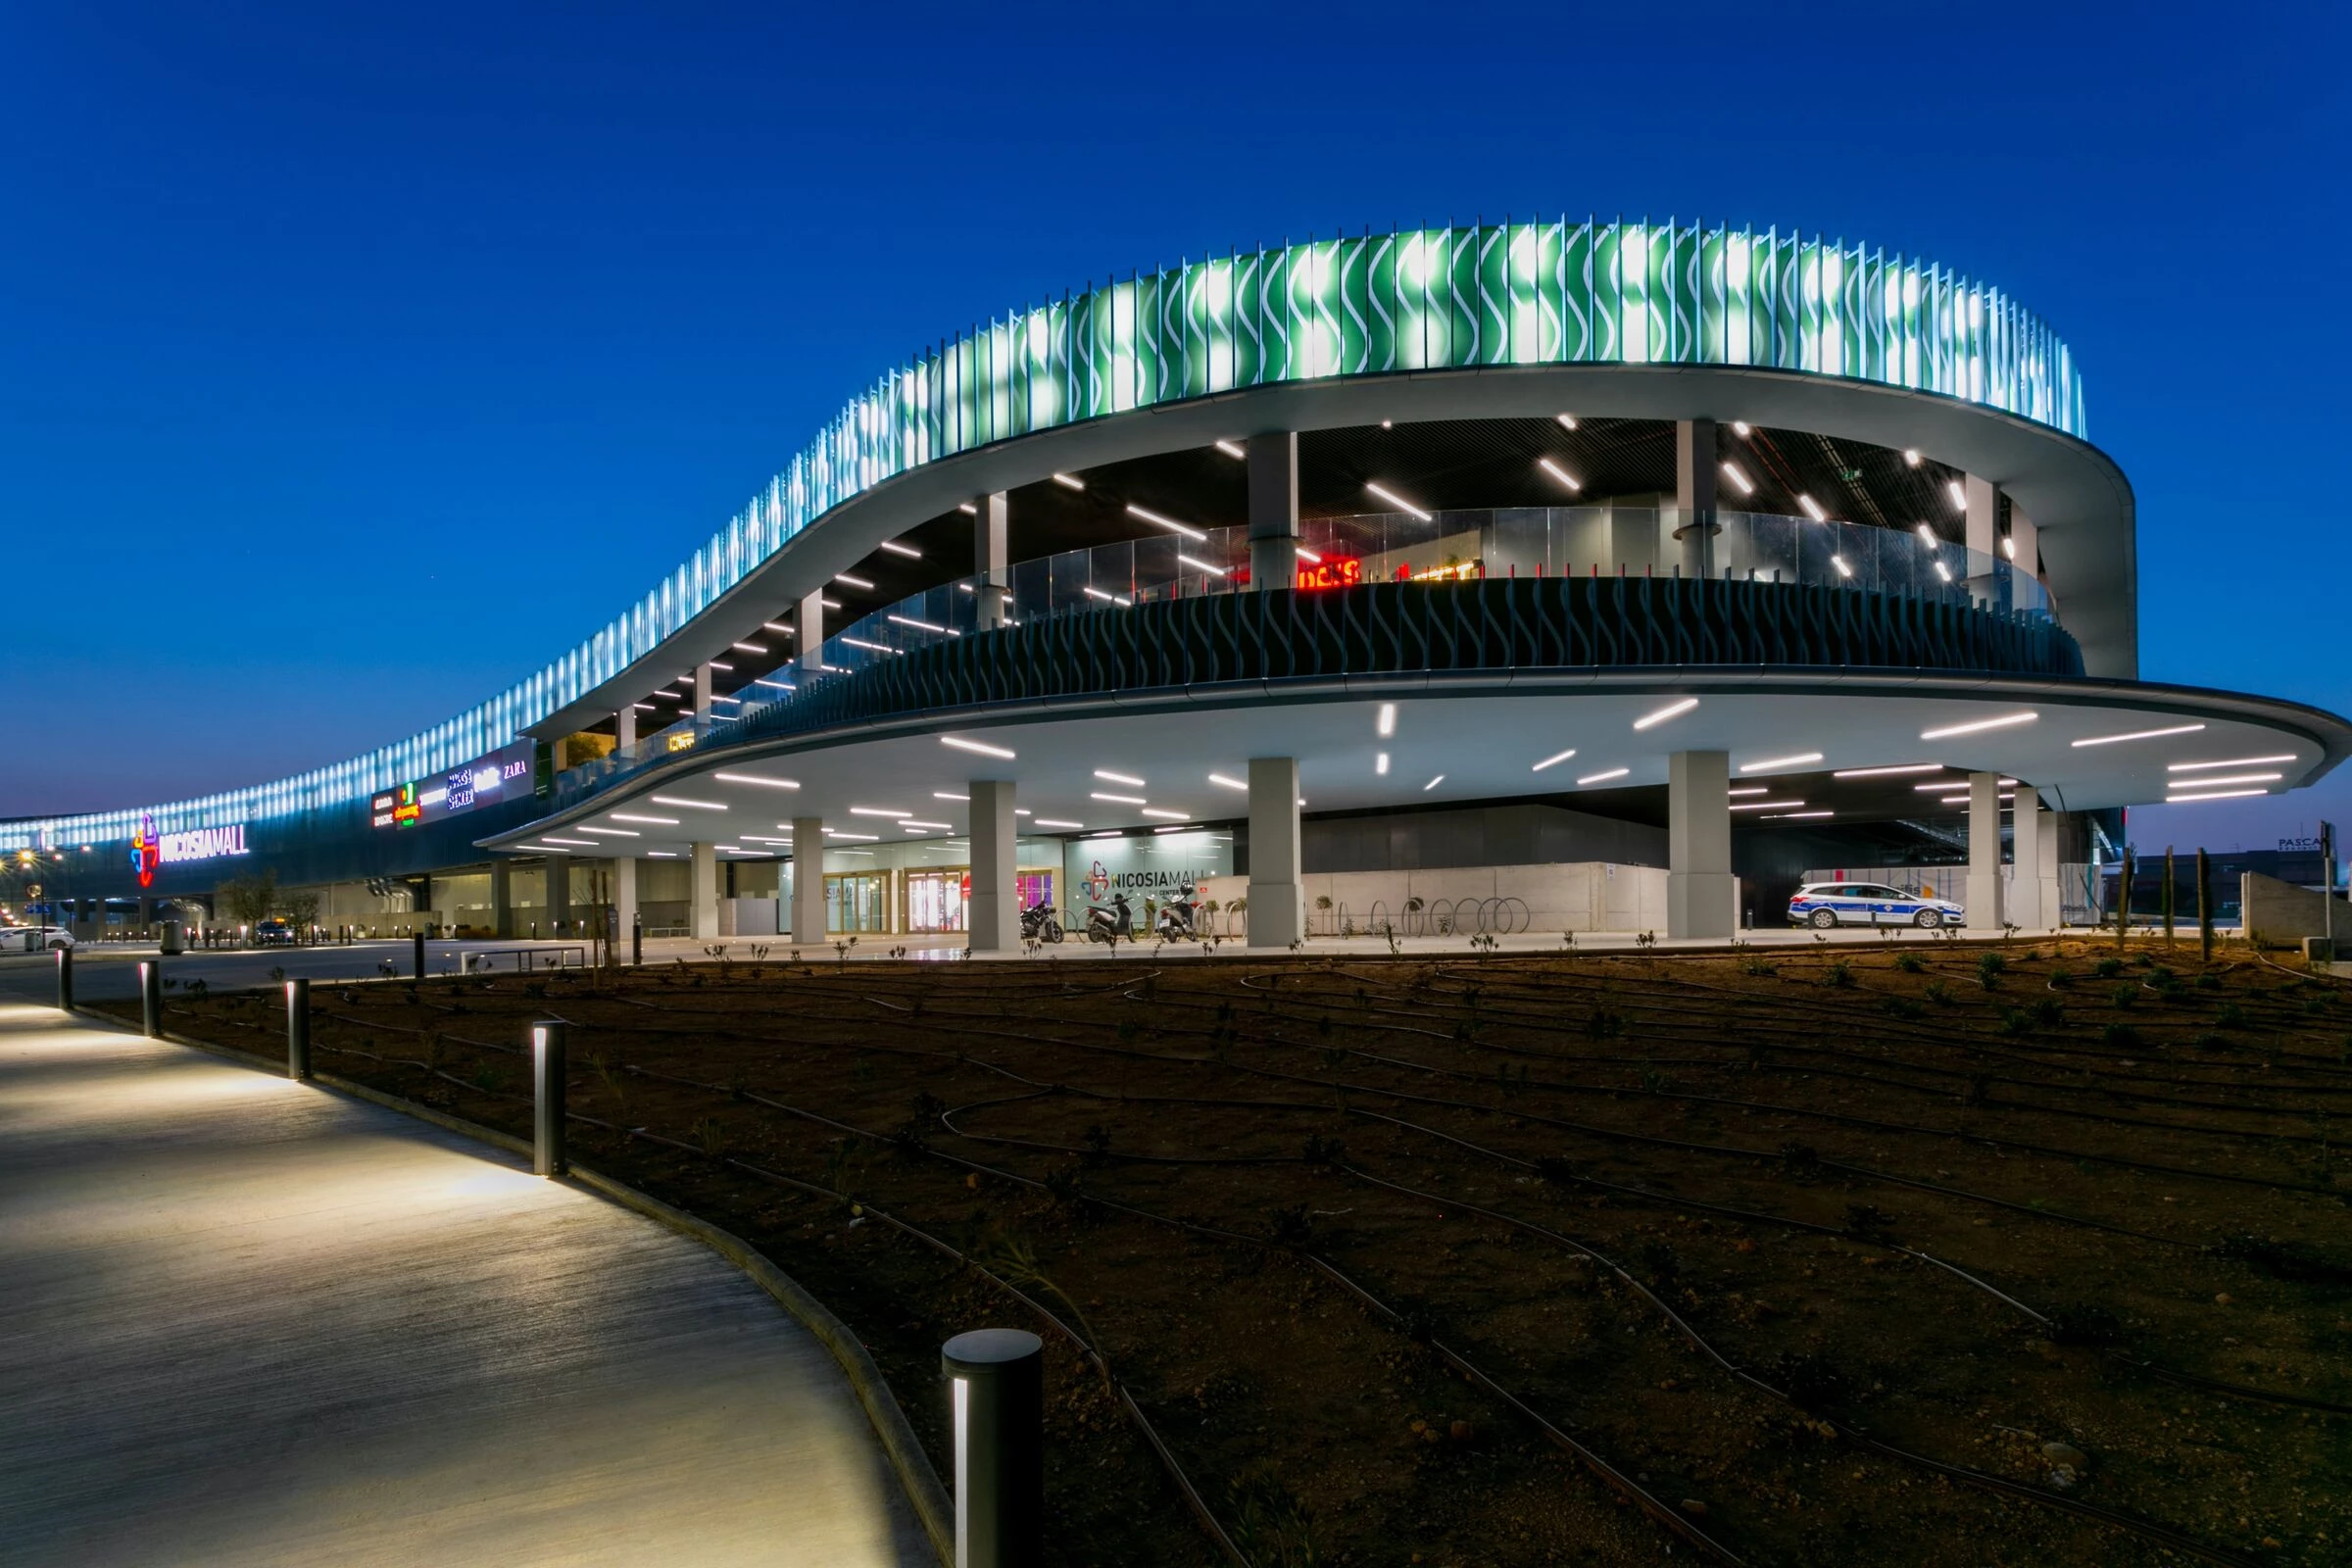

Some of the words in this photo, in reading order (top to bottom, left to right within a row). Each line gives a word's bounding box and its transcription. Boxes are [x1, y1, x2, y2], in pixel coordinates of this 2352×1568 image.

[504, 760, 527, 780] ZARA
[159, 824, 250, 863] NICOSIAMALL
[2278, 838, 2322, 847] PASCA
